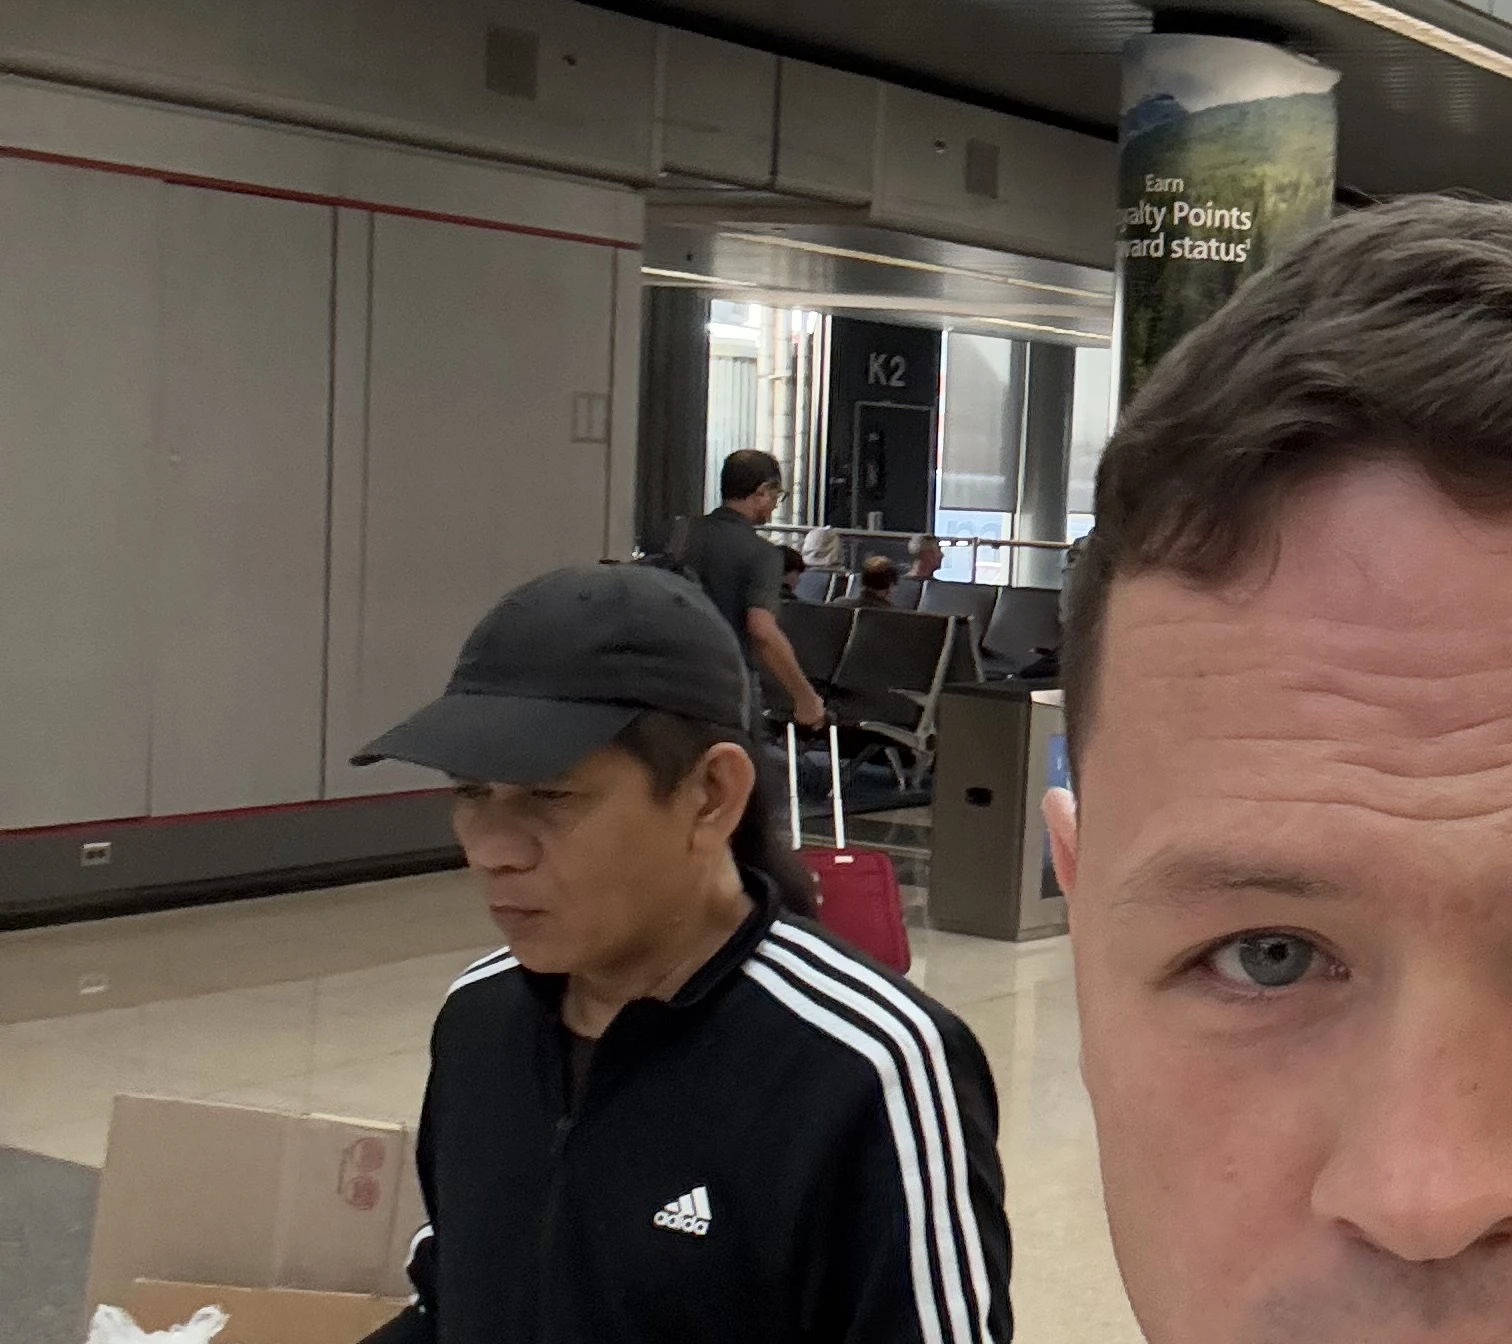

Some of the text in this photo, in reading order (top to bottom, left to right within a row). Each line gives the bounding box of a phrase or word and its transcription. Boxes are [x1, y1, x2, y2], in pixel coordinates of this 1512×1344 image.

[1144, 173, 1184, 193] Earn
[1173, 201, 1252, 231] Points
[867, 351, 906, 387] K2
